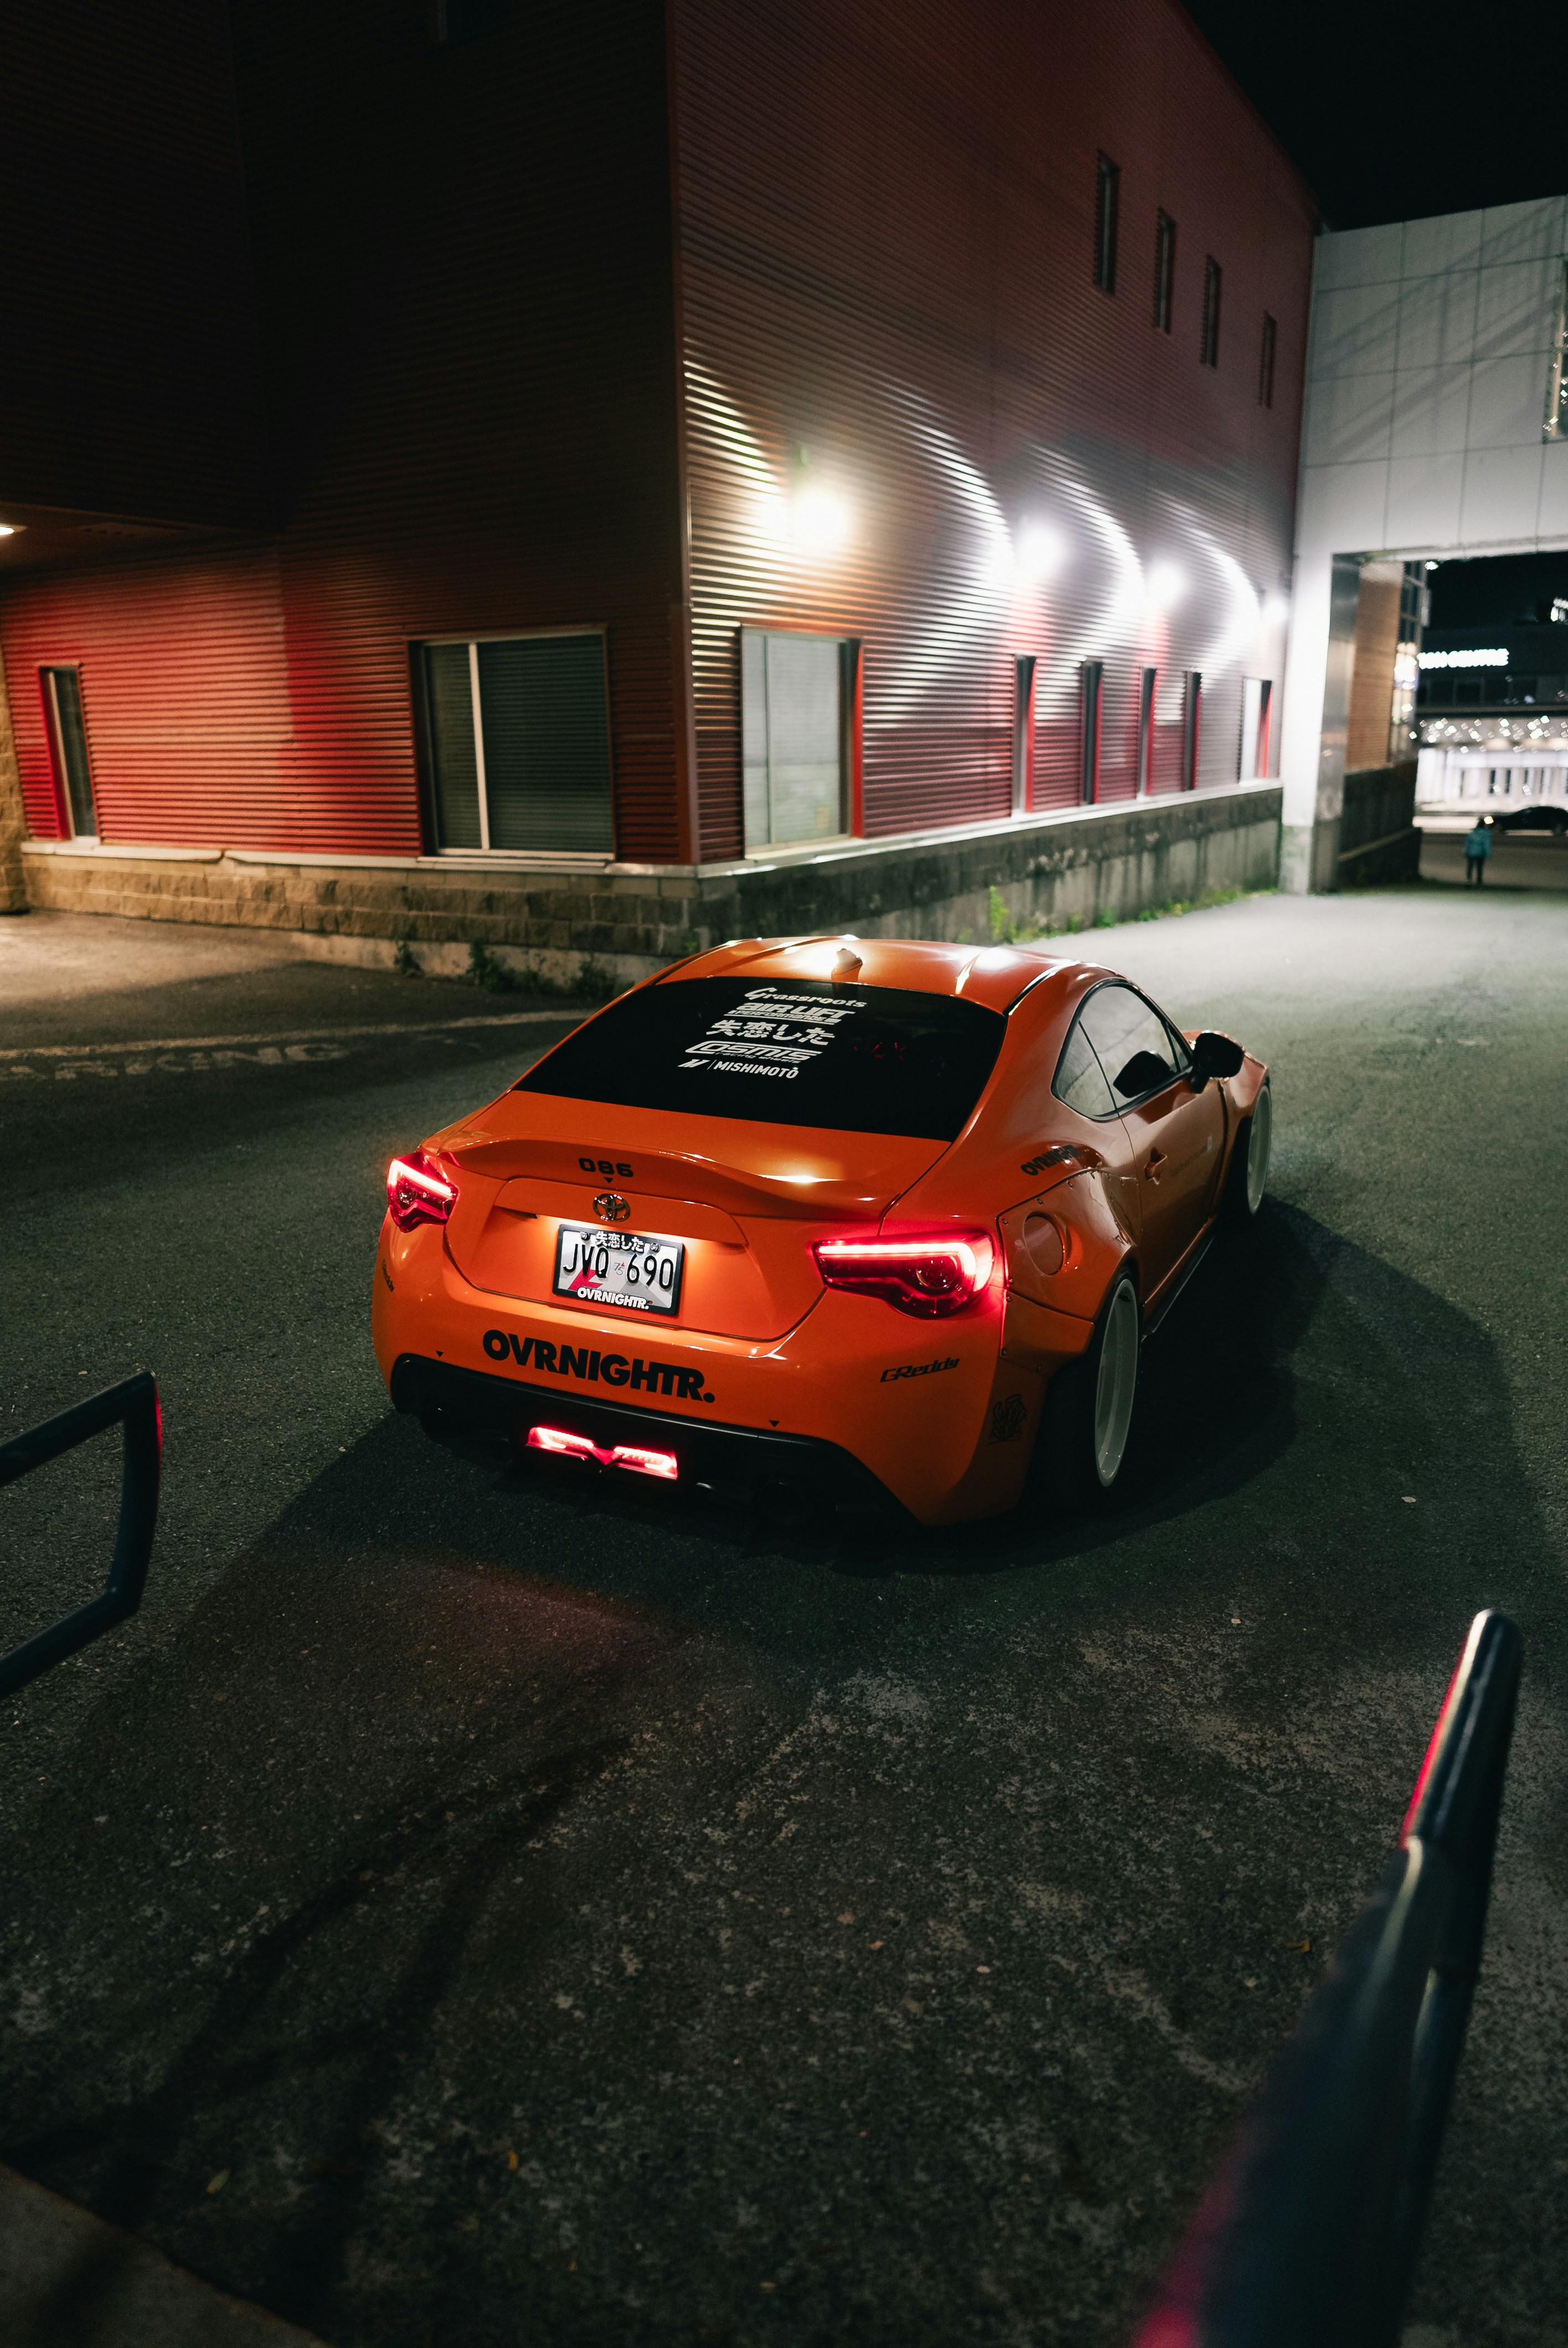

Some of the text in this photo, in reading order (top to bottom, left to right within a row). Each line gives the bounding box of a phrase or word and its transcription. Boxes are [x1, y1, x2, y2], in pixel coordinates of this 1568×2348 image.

[744, 987, 868, 1007] Grassroots
[706, 1019, 835, 1046] 失恋した
[713, 1061, 798, 1079] MISHIMOTO
[579, 1157, 634, 1177] 086
[595, 1231, 644, 1252] 失恋した
[563, 1243, 674, 1289] JVQ 690
[577, 1287, 649, 1310] OVRNIGHTR.
[483, 1330, 715, 1403] OVRNIGHTR.
[880, 1357, 960, 1383] GReddy
